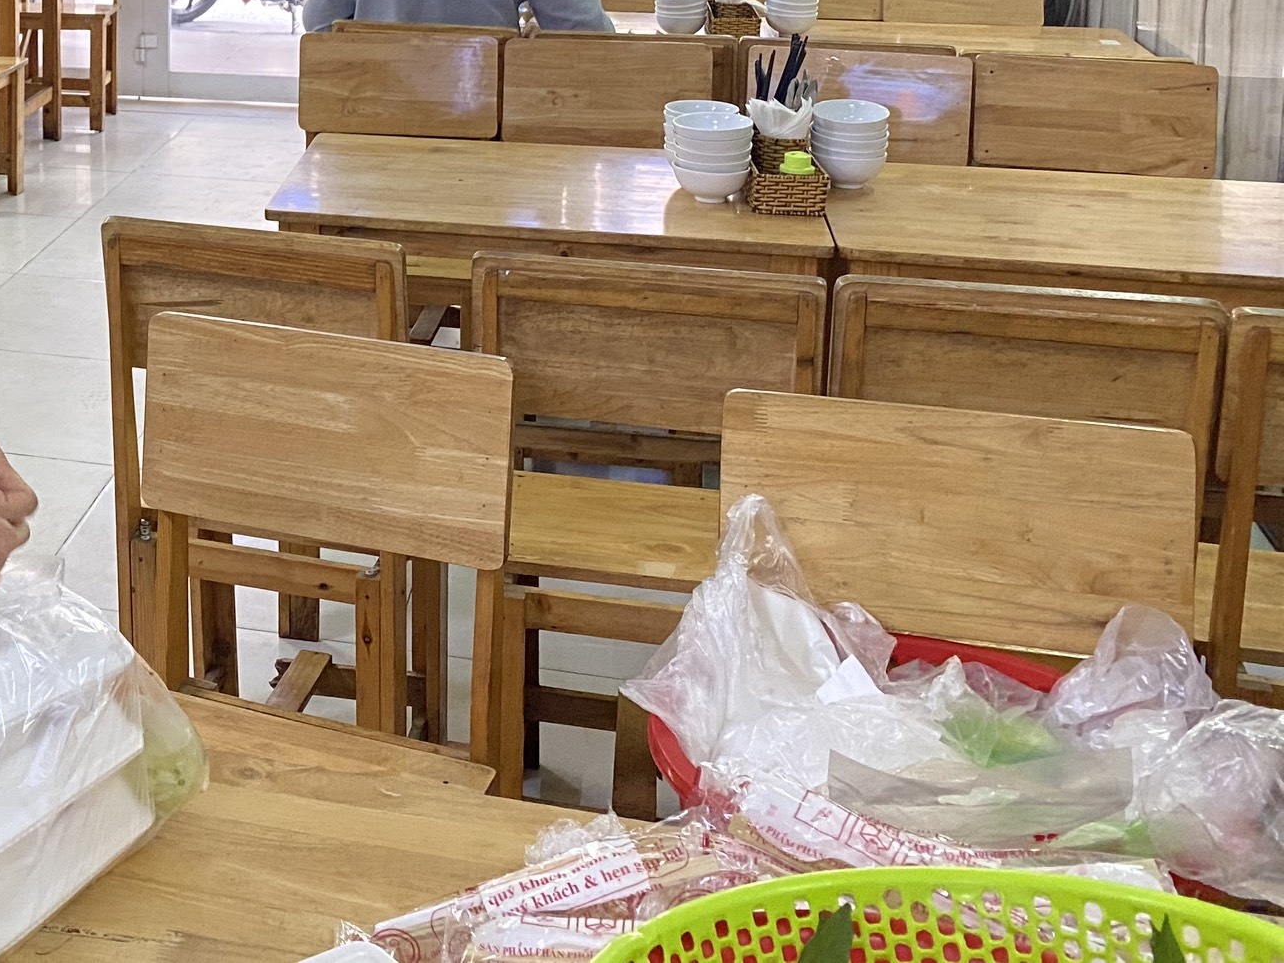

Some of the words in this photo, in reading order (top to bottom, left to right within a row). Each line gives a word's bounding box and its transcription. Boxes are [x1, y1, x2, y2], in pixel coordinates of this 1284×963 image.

[531, 882, 580, 909] khách
[584, 874, 598, 889] &
[600, 864, 631, 882] hẹn
